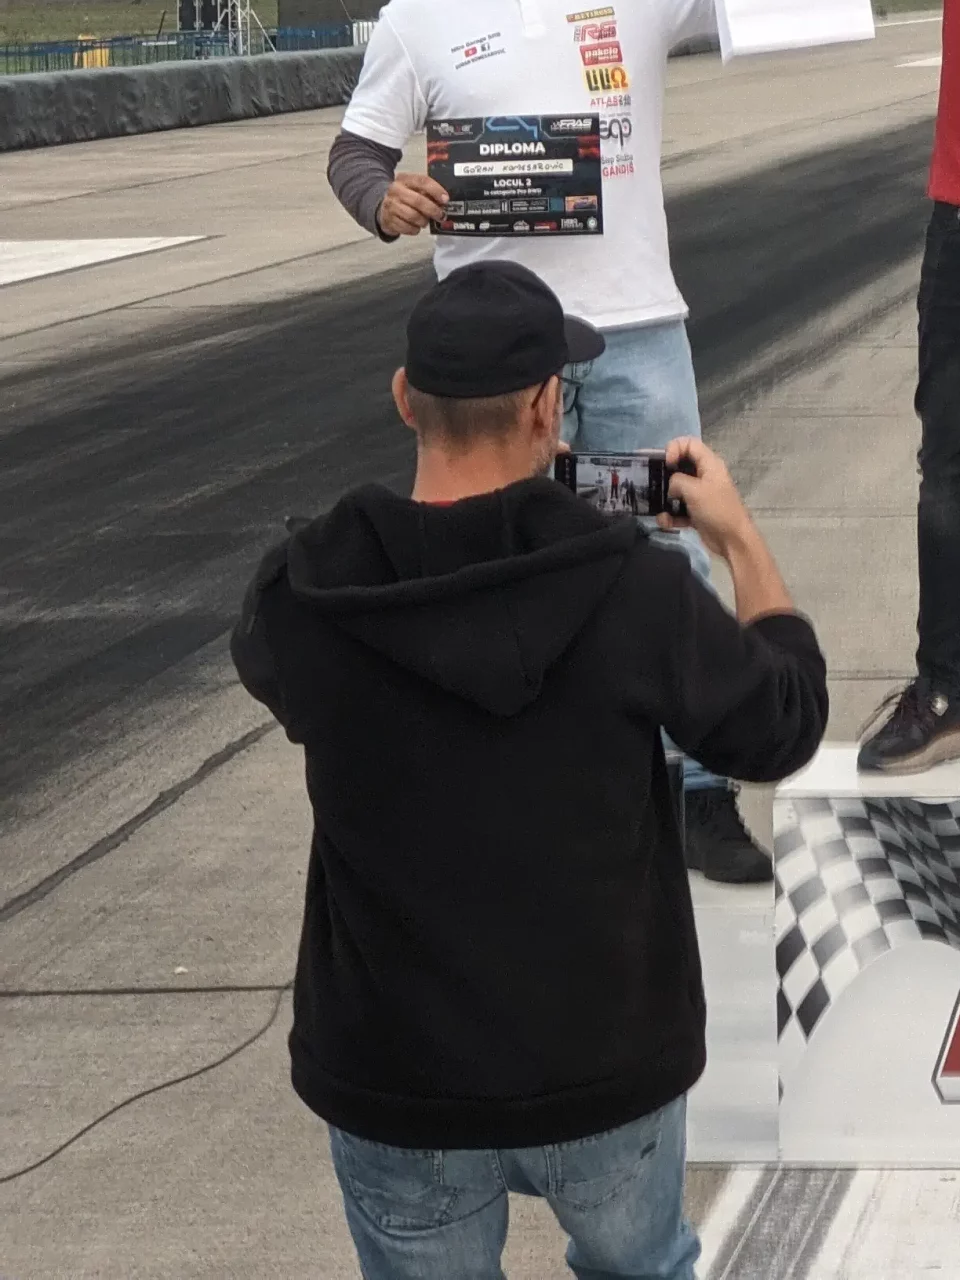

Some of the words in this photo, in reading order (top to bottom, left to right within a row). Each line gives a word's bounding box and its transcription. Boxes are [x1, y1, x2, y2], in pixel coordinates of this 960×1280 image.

[559, 118, 592, 128] FRAS
[479, 142, 546, 156] DIPLOMA
[493, 179, 524, 188] LOCUL
[525, 178, 532, 187] 2
